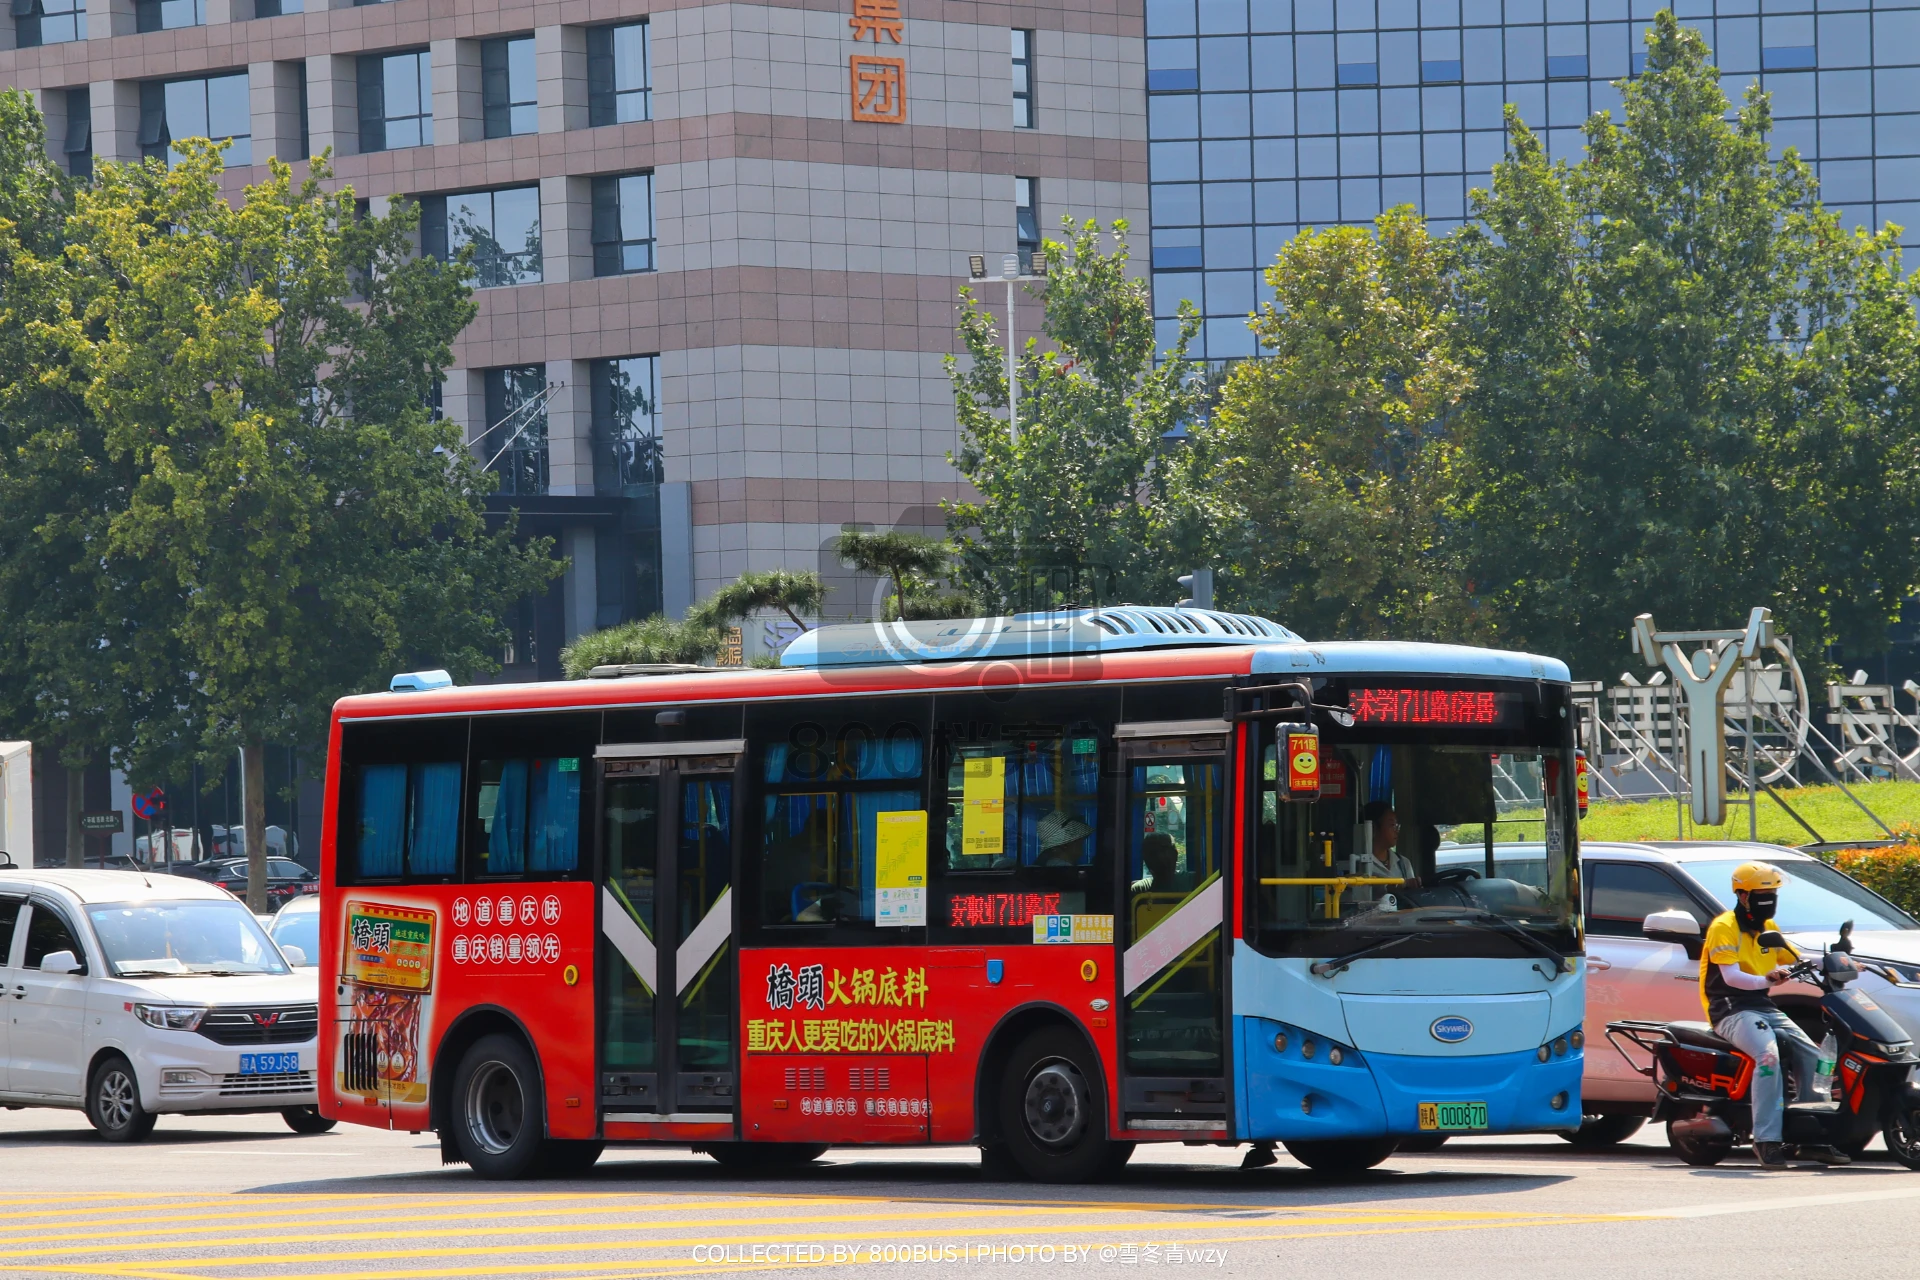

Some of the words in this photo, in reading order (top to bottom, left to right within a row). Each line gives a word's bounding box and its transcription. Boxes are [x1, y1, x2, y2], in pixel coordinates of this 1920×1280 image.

[1291, 738, 1317, 751] 711路
[452, 895, 561, 927] 地道重庆味
[452, 933, 561, 964] 重庆销量领先
[747, 1018, 956, 1053] 重庆人更爱吃的火锅底料
[1436, 1025, 1470, 1034] Skywell
[800, 1097, 858, 1115] 地道重庆味
